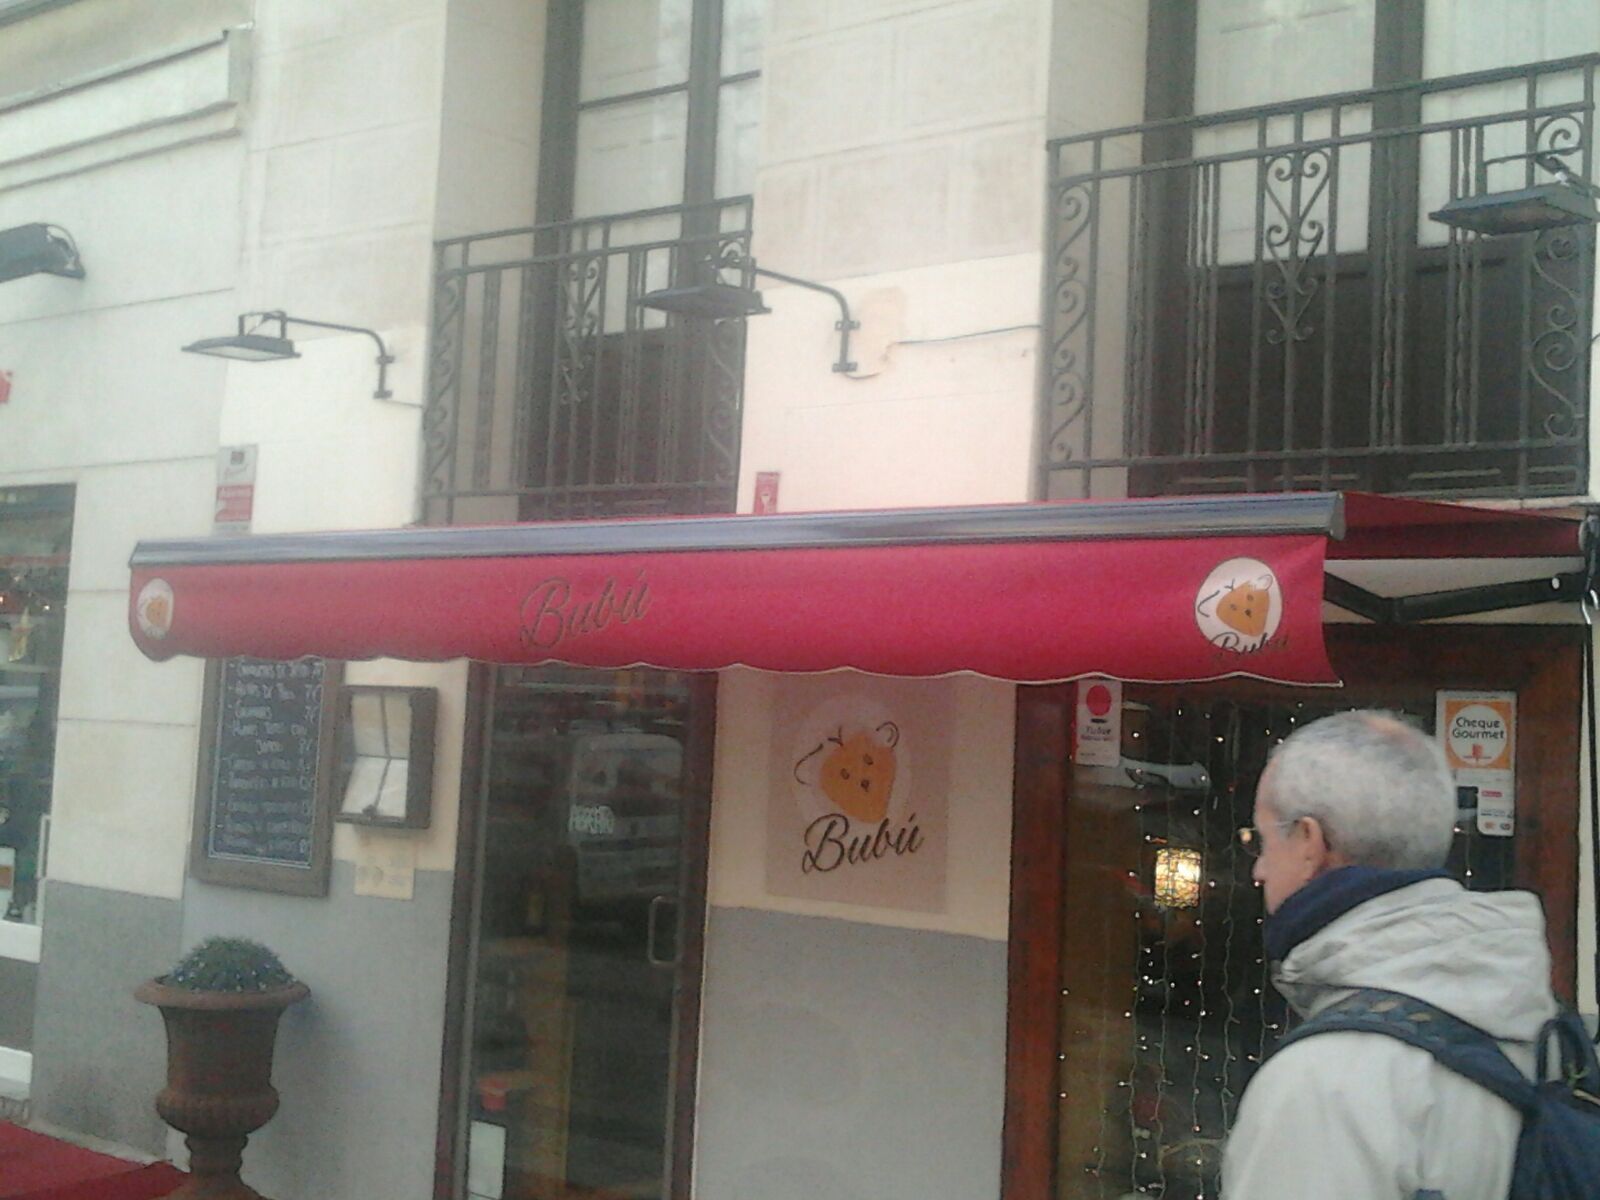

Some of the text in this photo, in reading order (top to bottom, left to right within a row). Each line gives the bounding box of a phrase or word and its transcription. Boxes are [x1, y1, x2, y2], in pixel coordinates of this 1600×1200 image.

[519, 567, 652, 651] Bubú
[1452, 729, 1506, 741] Gourmet
[1456, 716, 1501, 730] Cheque
[801, 811, 926, 876] Bubú
